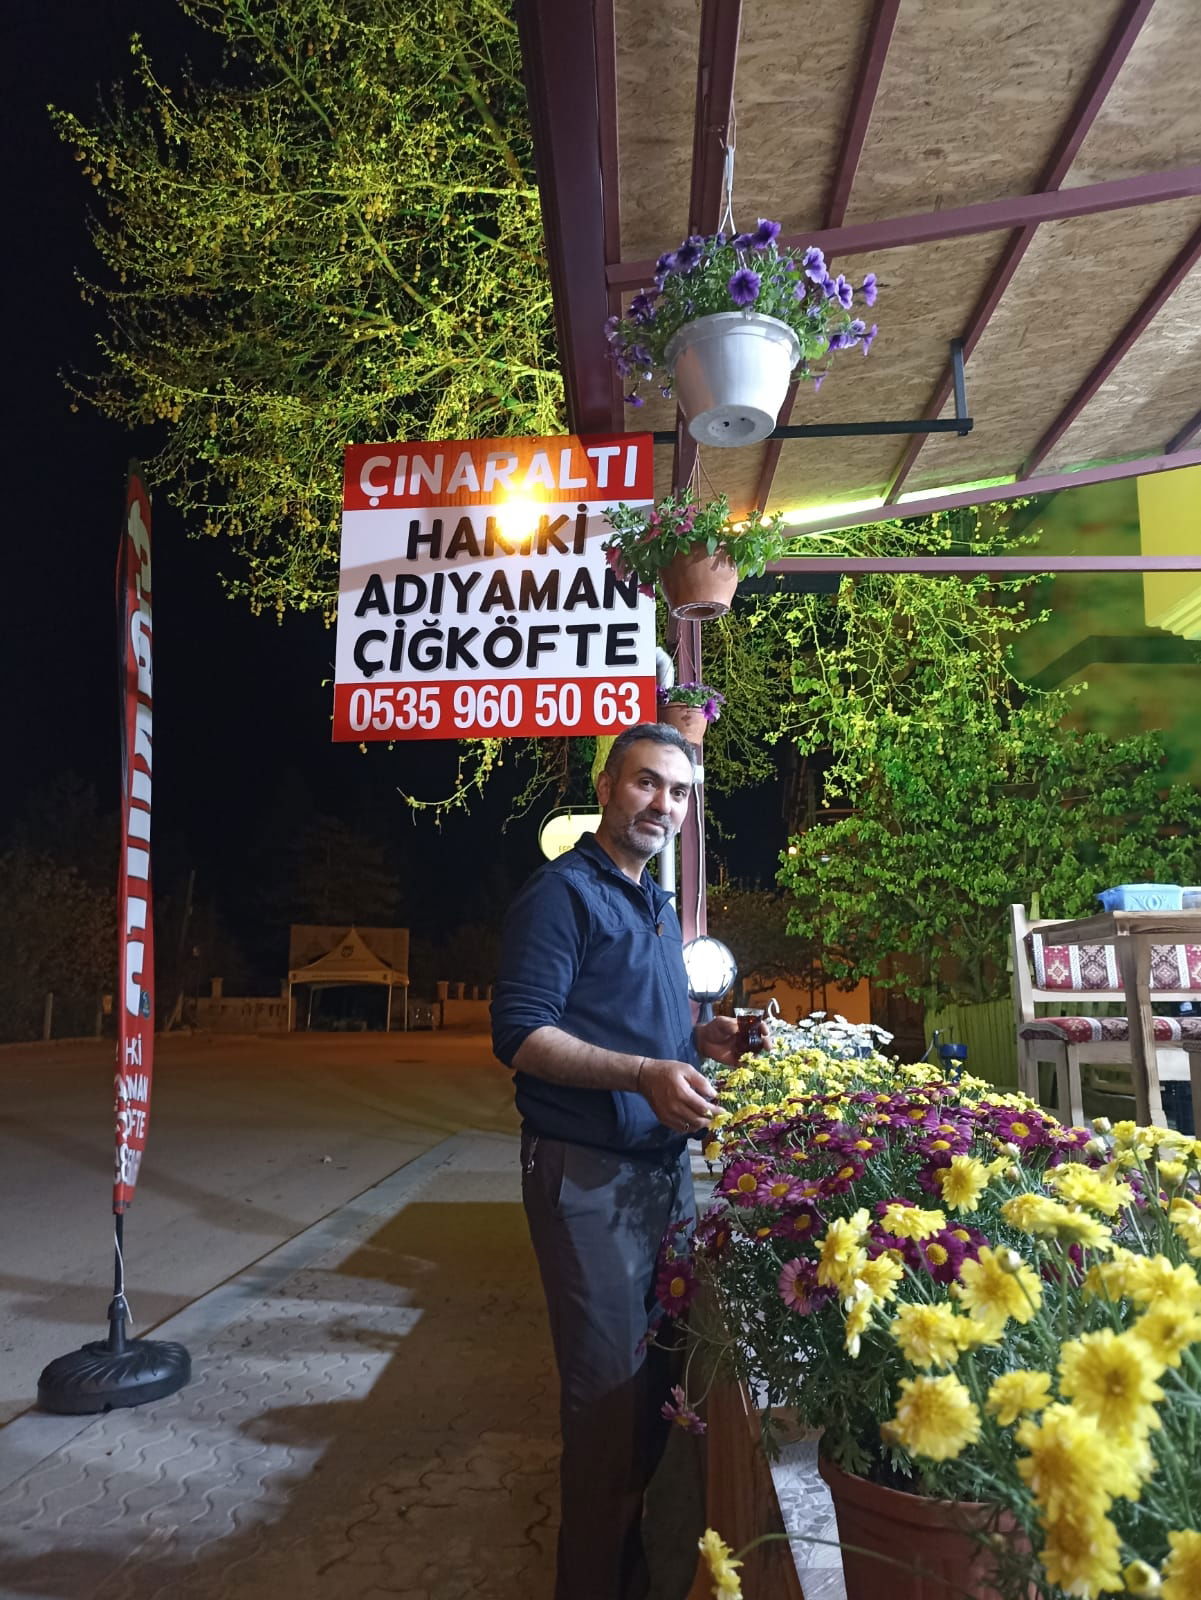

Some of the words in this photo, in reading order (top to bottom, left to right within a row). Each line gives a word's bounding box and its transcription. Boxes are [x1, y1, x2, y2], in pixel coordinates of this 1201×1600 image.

[360, 446, 638, 506] ÇINARALTI
[354, 567, 638, 616] ADIYAMAN
[353, 616, 639, 677] ÇİĞKÖFTE
[349, 687, 440, 731] 0535
[454, 684, 522, 728] 960
[535, 683, 581, 727] 50
[594, 682, 640, 726] 63
